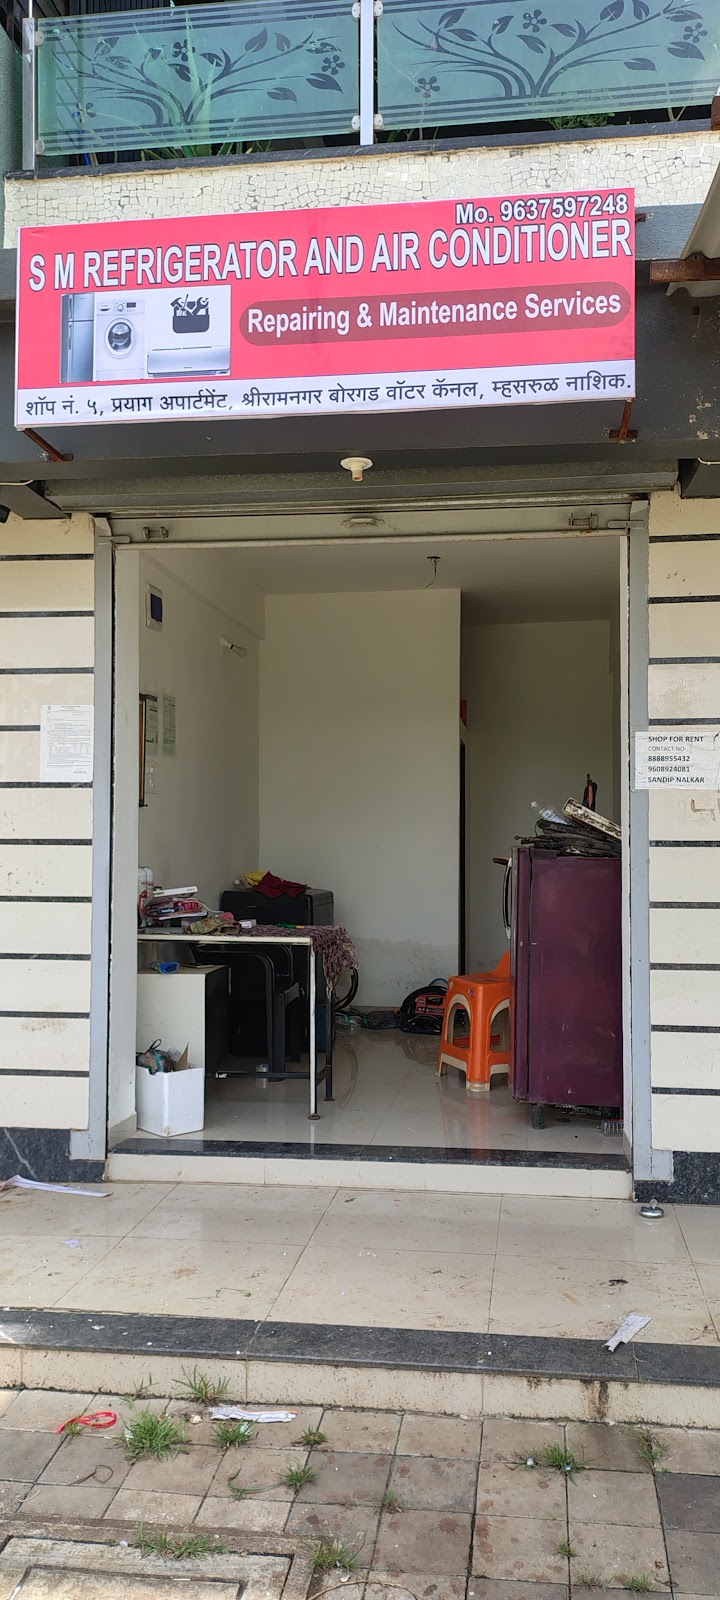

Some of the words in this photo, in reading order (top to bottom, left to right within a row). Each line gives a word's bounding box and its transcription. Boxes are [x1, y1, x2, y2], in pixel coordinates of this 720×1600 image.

[456, 202, 494, 225] Mo.
[500, 193, 629, 222] 9637597248
[28, 254, 47, 292] S
[54, 252, 74, 290] M
[83, 239, 298, 288] REFRIGERATOR
[303, 234, 364, 276] AND
[370, 231, 421, 272] AIR
[428, 218, 632, 268] CONDITIONER
[247, 304, 350, 337] Repairing
[356, 302, 373, 328] &
[379, 299, 518, 327] Maintenance
[524, 291, 622, 319] Services
[26, 397, 57, 416] शॉप
[110, 393, 153, 413] प्रयाग
[159, 388, 234, 411] अपार्टमेंट,
[241, 387, 323, 406] श्रीरामनगर
[328, 383, 381, 403] बोरगड
[386, 380, 426, 400] वॉटर
[432, 378, 484, 400] कॅनल,
[492, 377, 559, 397] म्हसरुळ
[565, 370, 631, 392] नाशिक.
